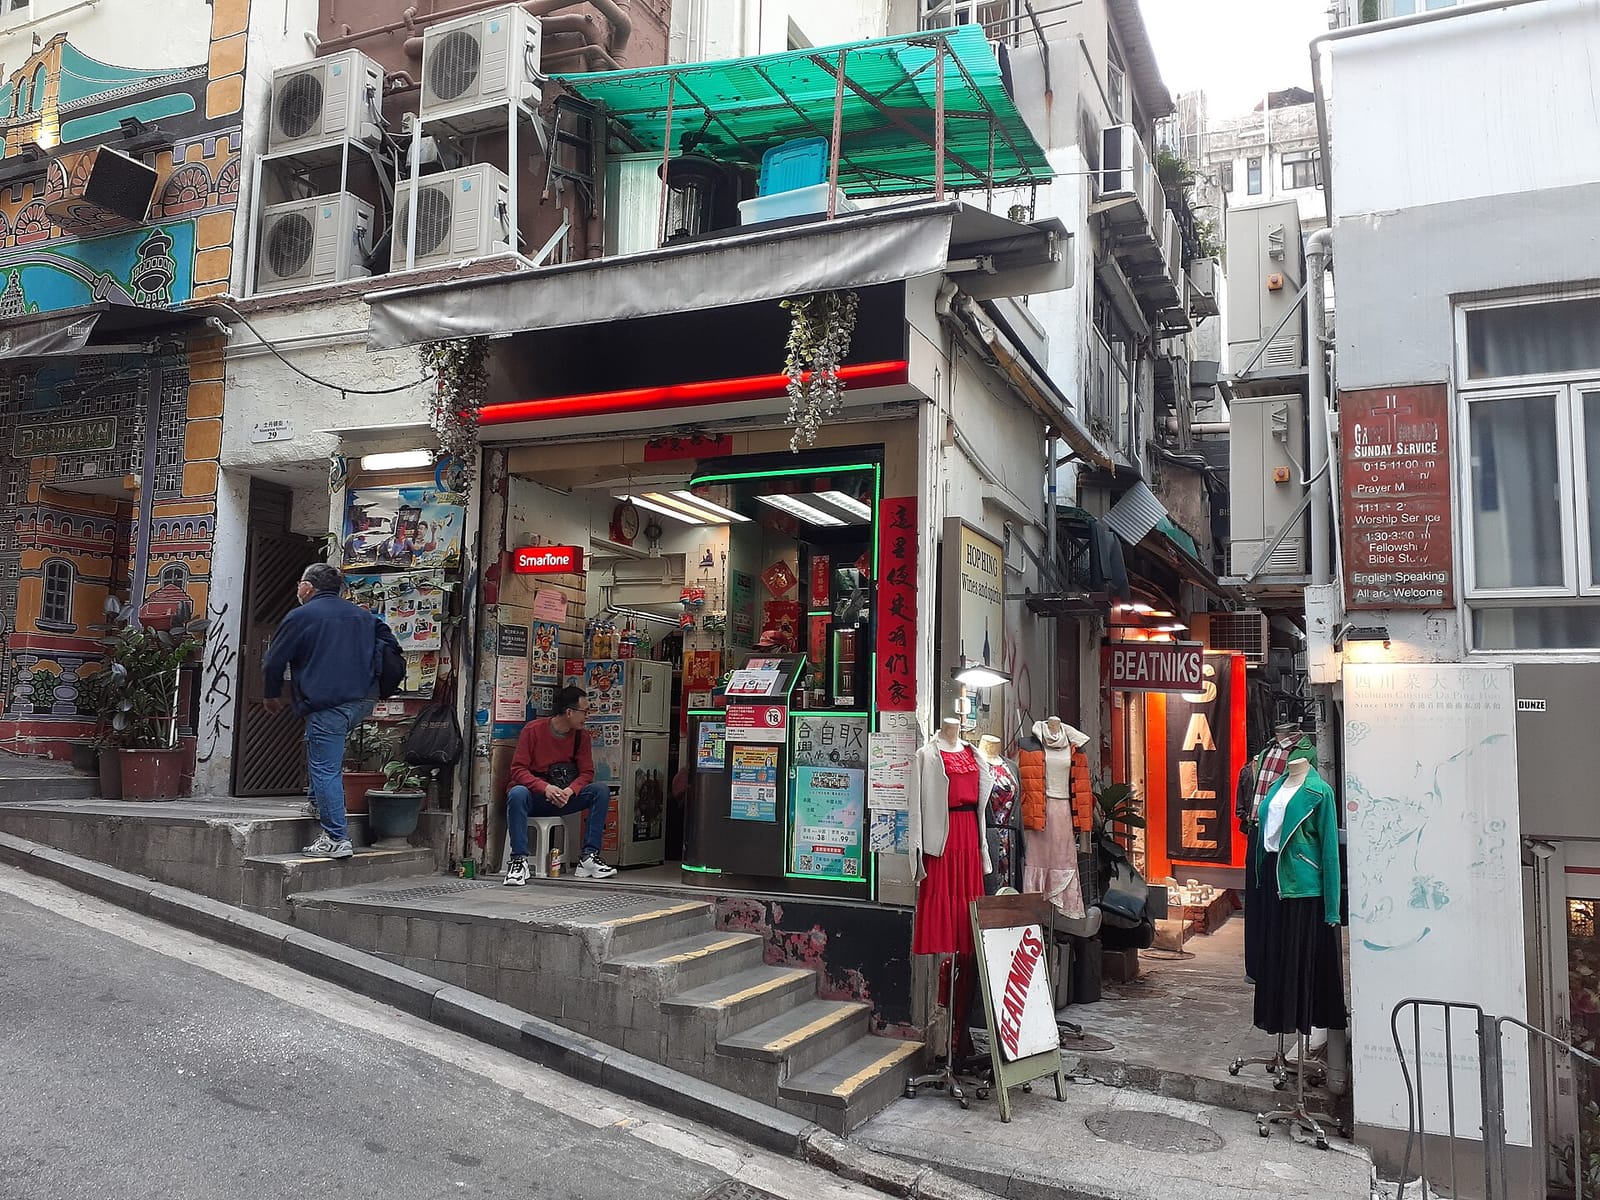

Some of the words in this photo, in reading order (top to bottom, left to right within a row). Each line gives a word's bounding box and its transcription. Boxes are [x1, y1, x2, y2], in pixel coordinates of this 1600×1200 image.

[267, 431, 278, 440] 29
[1354, 444, 1393, 458] SUNDAY
[1396, 442, 1437, 455] SERVICE
[1357, 484, 1392, 495] Prayer
[1355, 514, 1398, 526] Worship
[1401, 513, 1441, 523] Serice
[519, 553, 570, 567] SmarTone
[1368, 554, 1395, 564] Bible
[1398, 553, 1429, 563] Sty
[961, 572, 978, 596] Wines
[1354, 573, 1392, 585] English
[1395, 571, 1445, 584] Speaking
[1356, 588, 1370, 598] All
[1113, 650, 1201, 683] BEATNIKS
[1518, 701, 1546, 710] DUNZE
[1000, 927, 1043, 1057] BEATNIKS
